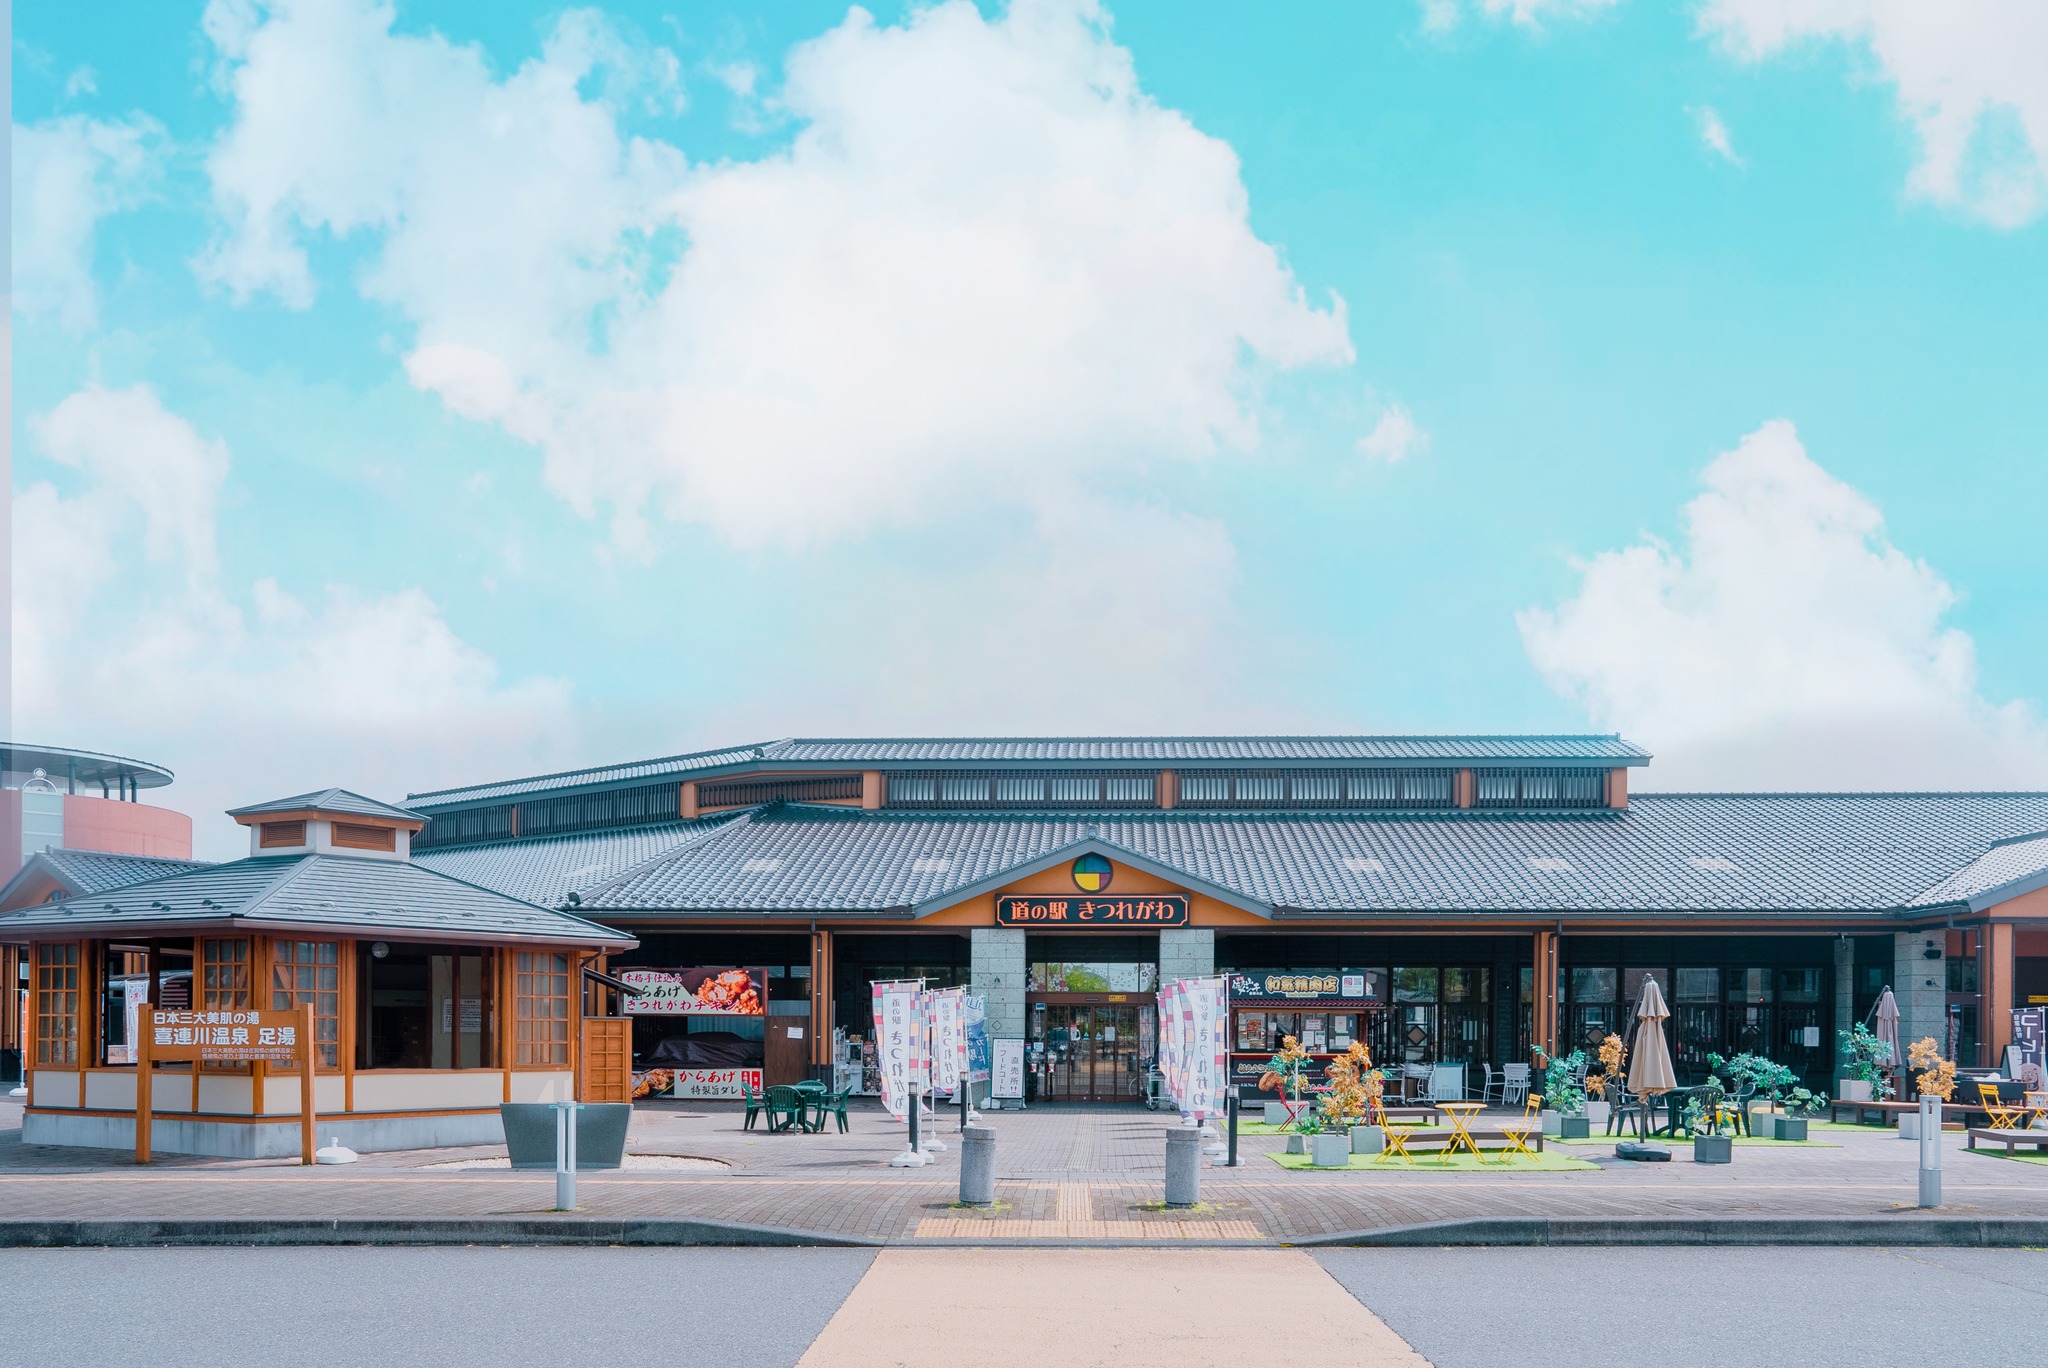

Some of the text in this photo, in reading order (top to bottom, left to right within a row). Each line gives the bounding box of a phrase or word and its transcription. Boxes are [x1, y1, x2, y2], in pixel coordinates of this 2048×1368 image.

[1011, 901, 1175, 920] 道の駅 きつれがわ
[626, 972, 683, 983] 本格手仕込み
[641, 985, 681, 998] らあげ
[627, 1000, 738, 1011] きつれがわチキン
[154, 1011, 260, 1025] 日本三大美肌の湯
[154, 1027, 296, 1045] 喜連川温泉 足湯
[679, 1070, 737, 1083] からあげ
[998, 1049, 1007, 1092] フードコート
[1010, 1056, 1019, 1085] 直売所
[691, 1085, 739, 1096] 特製旨ダレ
